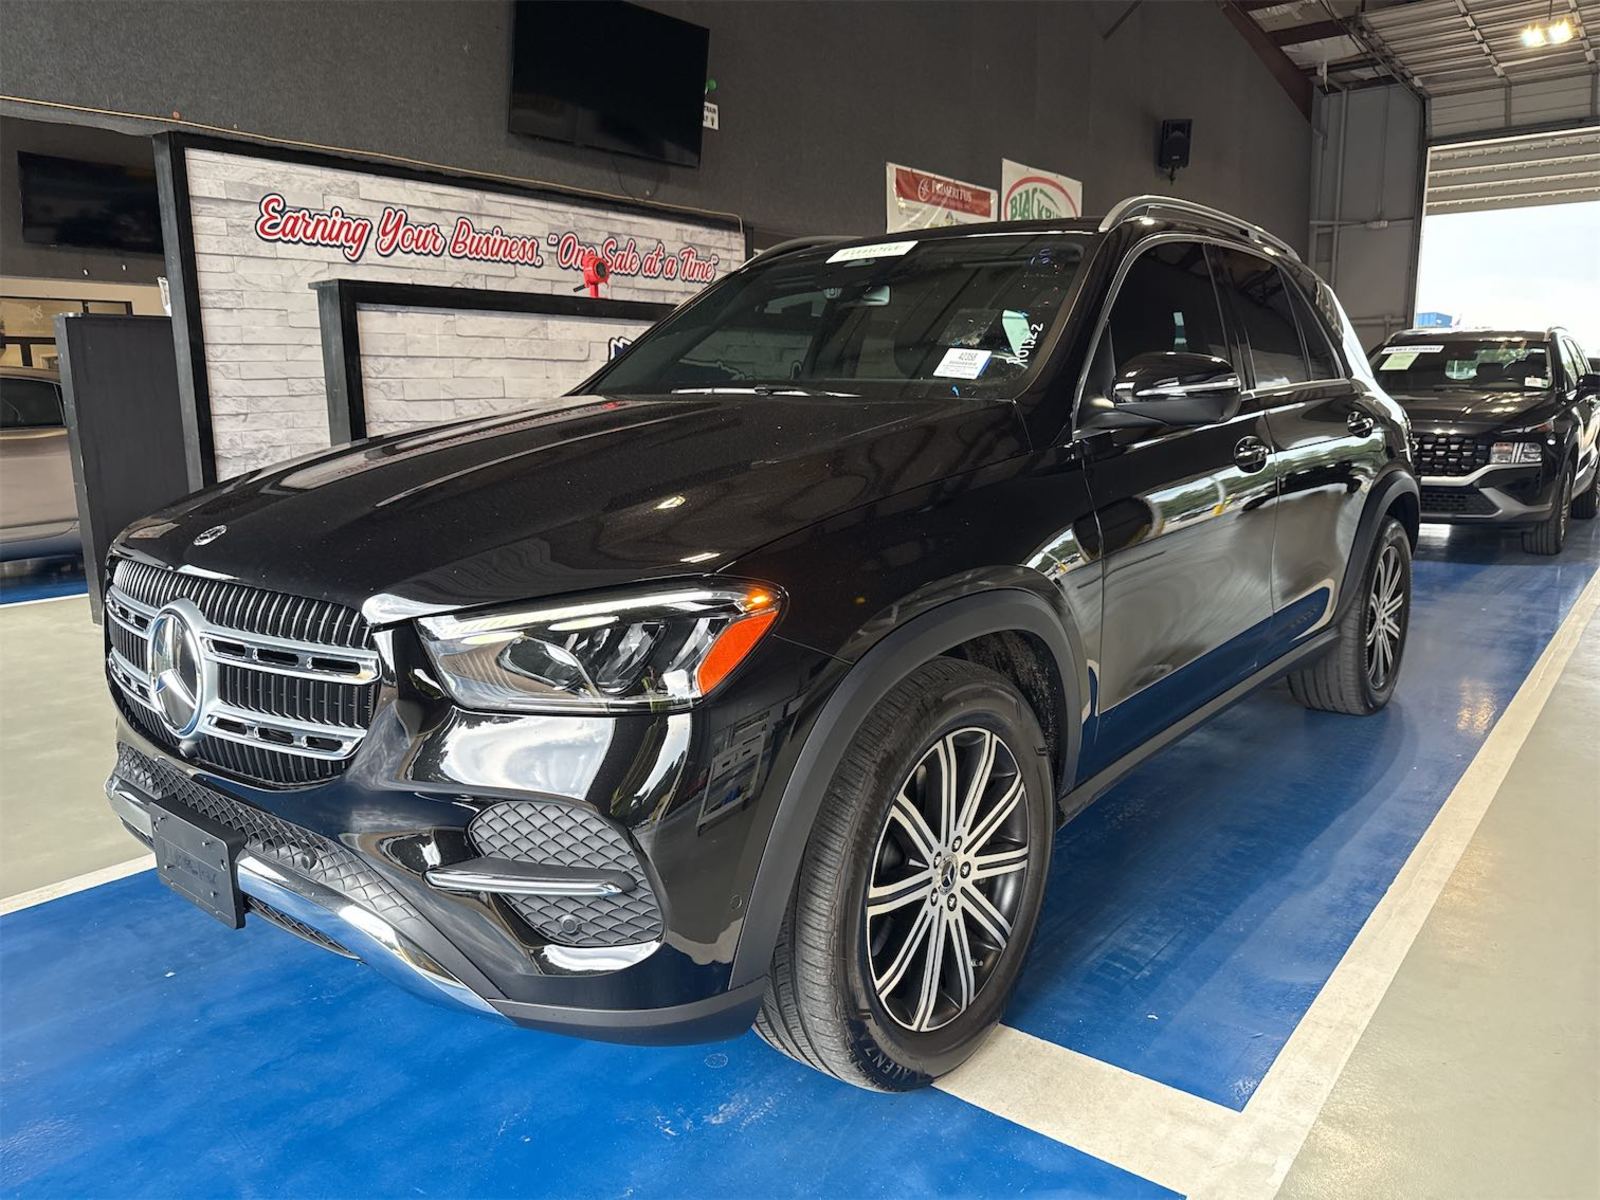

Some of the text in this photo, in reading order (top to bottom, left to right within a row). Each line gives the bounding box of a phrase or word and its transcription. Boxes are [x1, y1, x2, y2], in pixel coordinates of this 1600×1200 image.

[256, 193, 372, 261] Earning
[377, 208, 445, 256] Your
[603, 238, 640, 275] Sale
[642, 242, 664, 278] at
[664, 256, 678, 279] a
